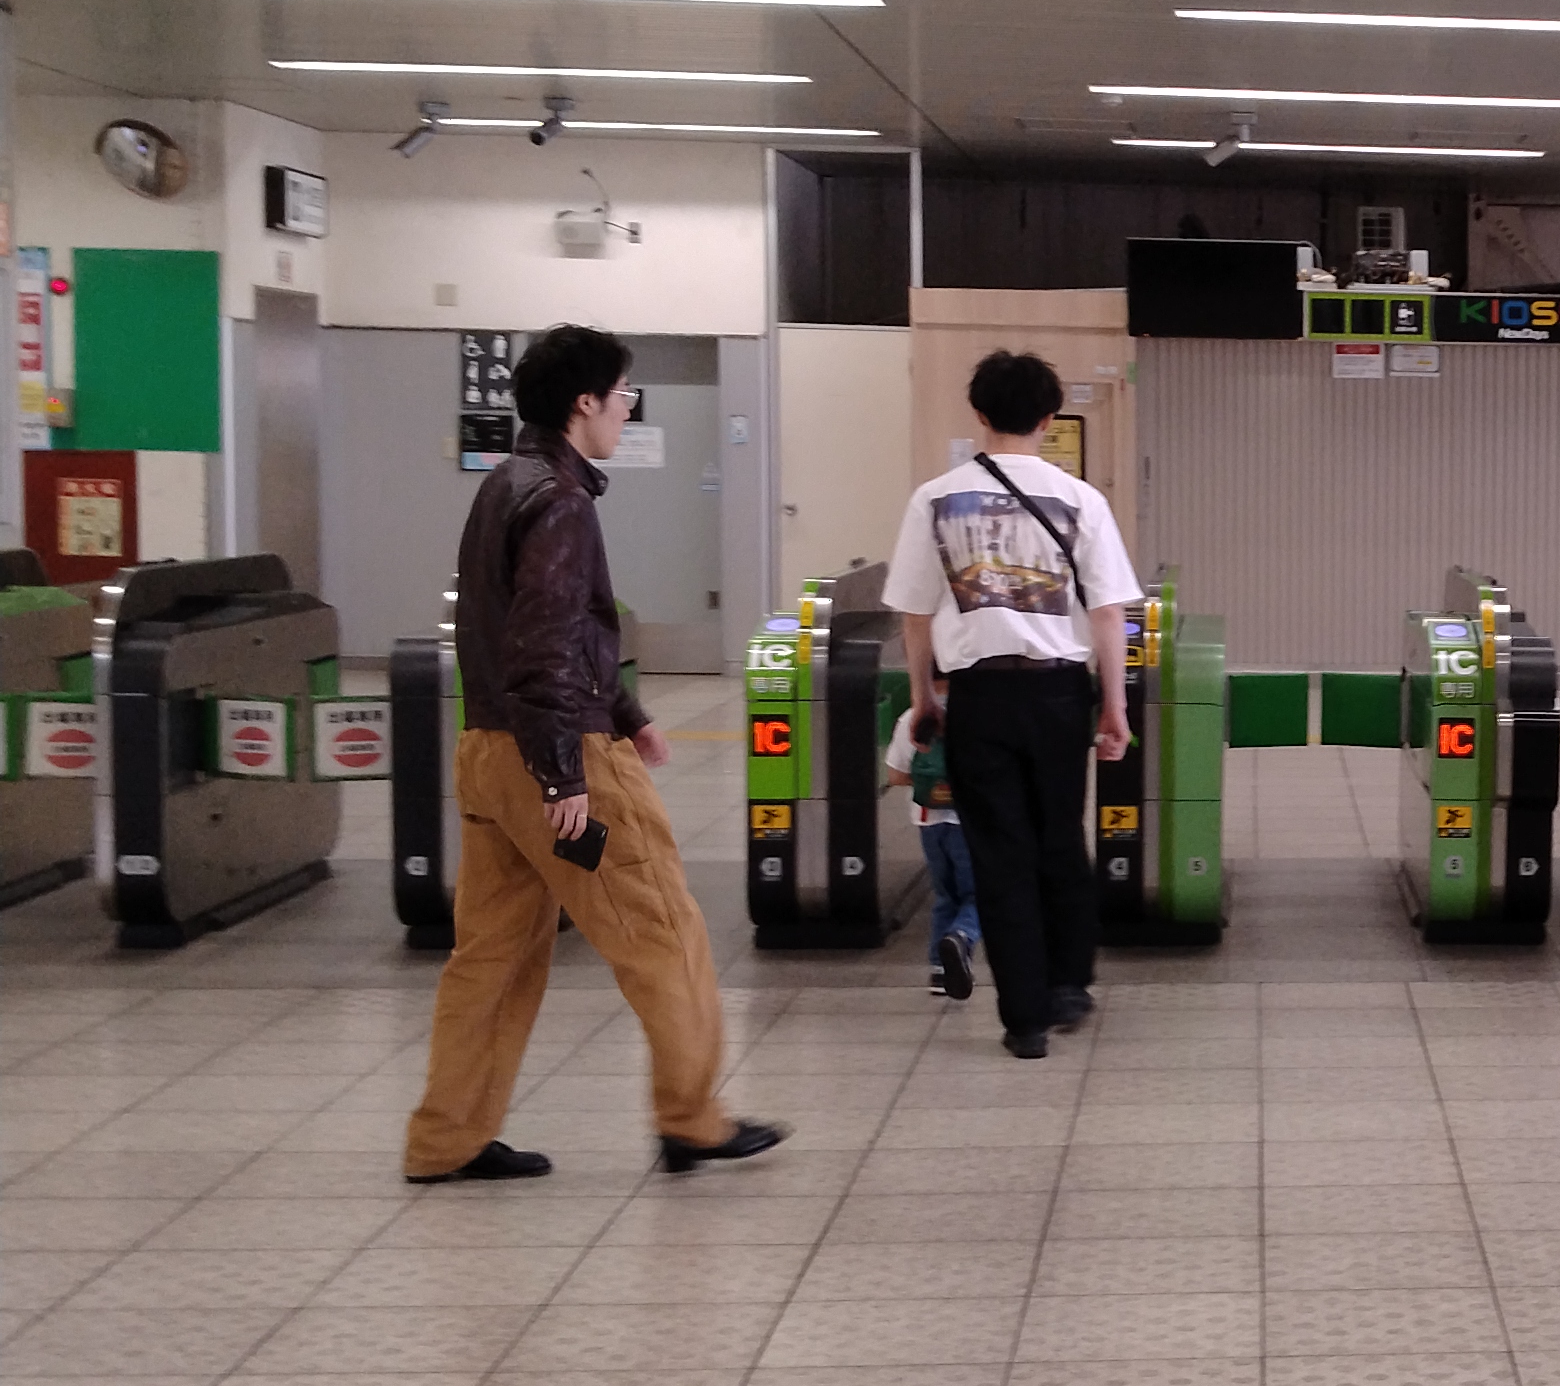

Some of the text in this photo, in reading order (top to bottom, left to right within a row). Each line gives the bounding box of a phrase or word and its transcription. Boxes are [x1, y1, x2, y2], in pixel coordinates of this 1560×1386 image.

[748, 644, 793, 668] IC
[1435, 650, 1479, 675] IC
[753, 721, 791, 753] IC
[1439, 724, 1474, 754] IC
